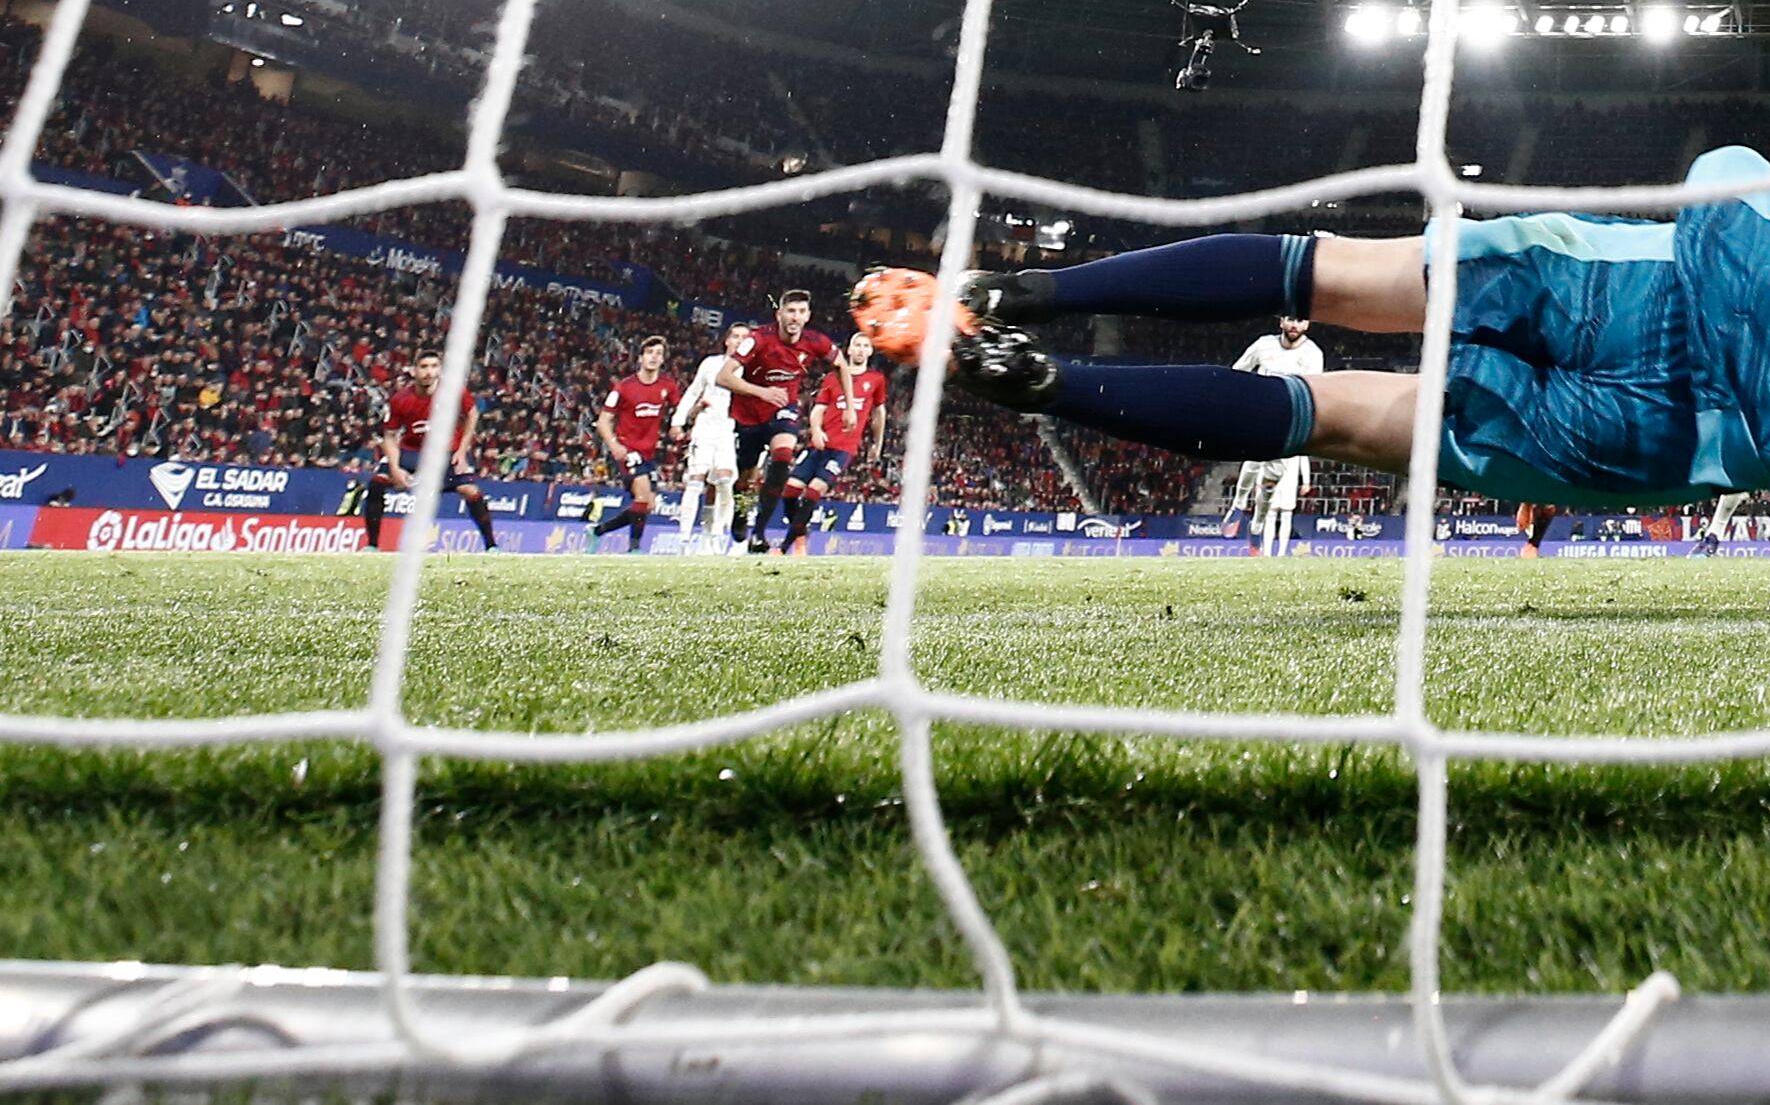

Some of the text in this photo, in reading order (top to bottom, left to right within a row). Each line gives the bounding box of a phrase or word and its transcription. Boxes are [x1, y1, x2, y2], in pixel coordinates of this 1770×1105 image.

[196, 467, 288, 492] EL SADAR
[122, 512, 367, 552] LaLiga Santander
[1450, 545, 1522, 558] SLOT.CO
